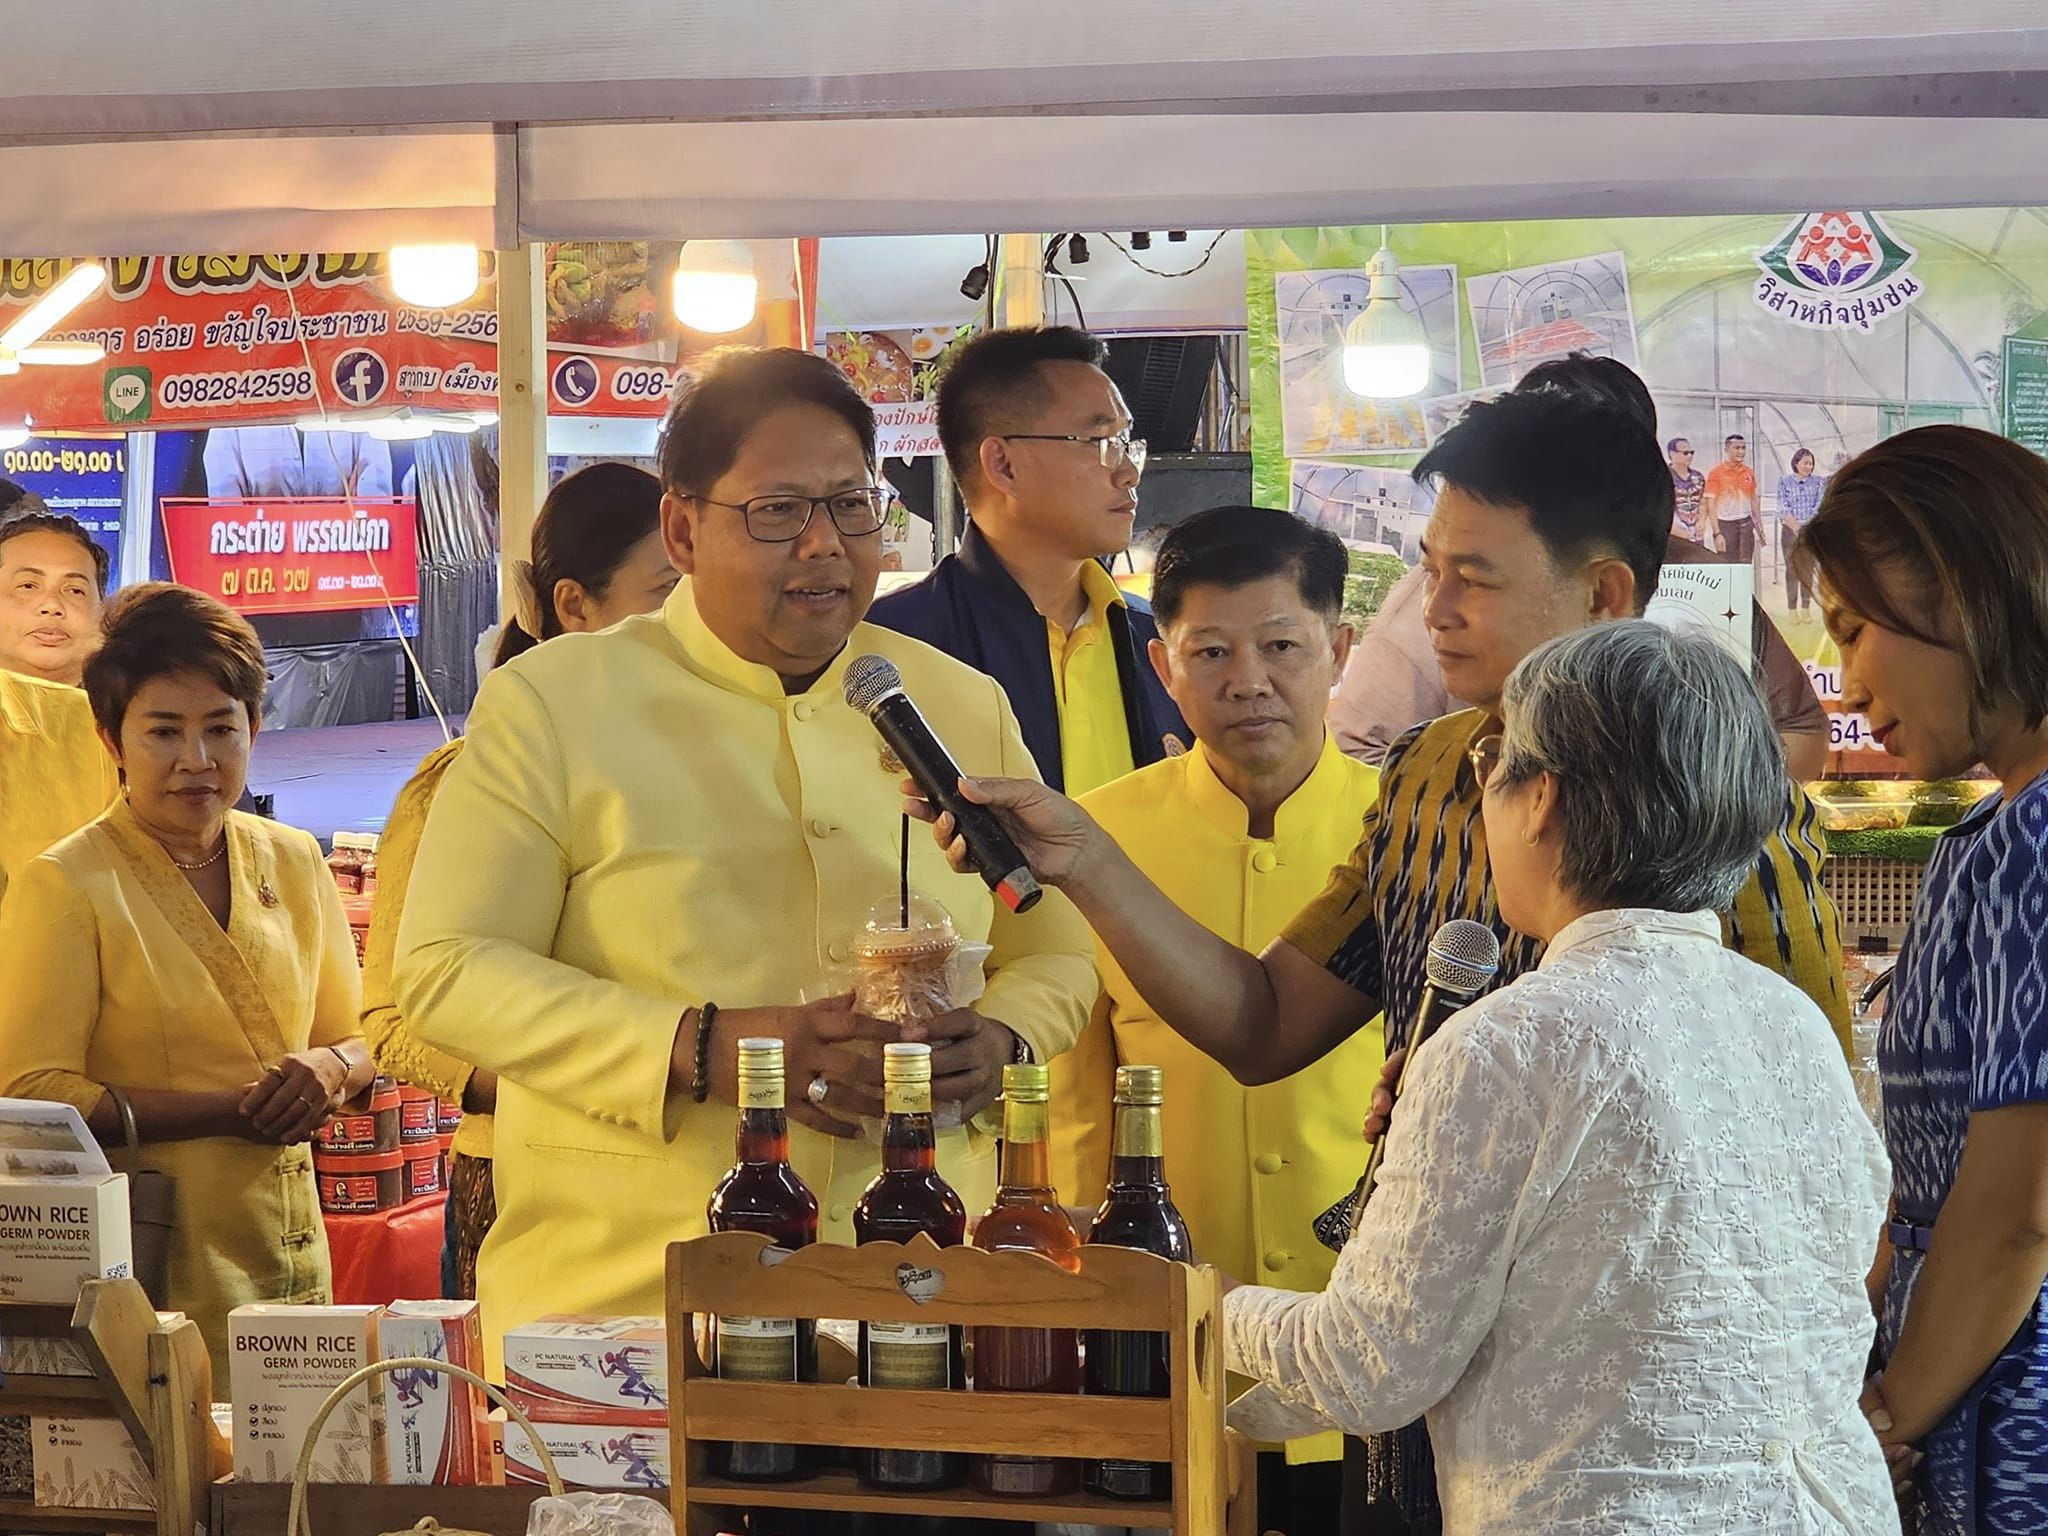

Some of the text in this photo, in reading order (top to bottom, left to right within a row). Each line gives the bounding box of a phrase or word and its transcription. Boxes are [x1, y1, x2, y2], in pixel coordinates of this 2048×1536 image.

[1757, 277, 1919, 329] วิสาหกิจชุมชน
[136, 318, 193, 350] อร่อย
[206, 307, 387, 351] ขวัญใจประชาชน
[116, 386, 139, 398] LINE
[164, 371, 312, 403] 0982842598
[210, 508, 285, 555] กระต่าย
[50, 1206, 89, 1224] RICE
[0, 1227, 90, 1241] GERM POWDER
[236, 1335, 357, 1353] BROWN RICE
[263, 1356, 357, 1369] GERM POWDER
[545, 1353, 576, 1361] NATURAL
[546, 1441, 578, 1449] NATURAL
